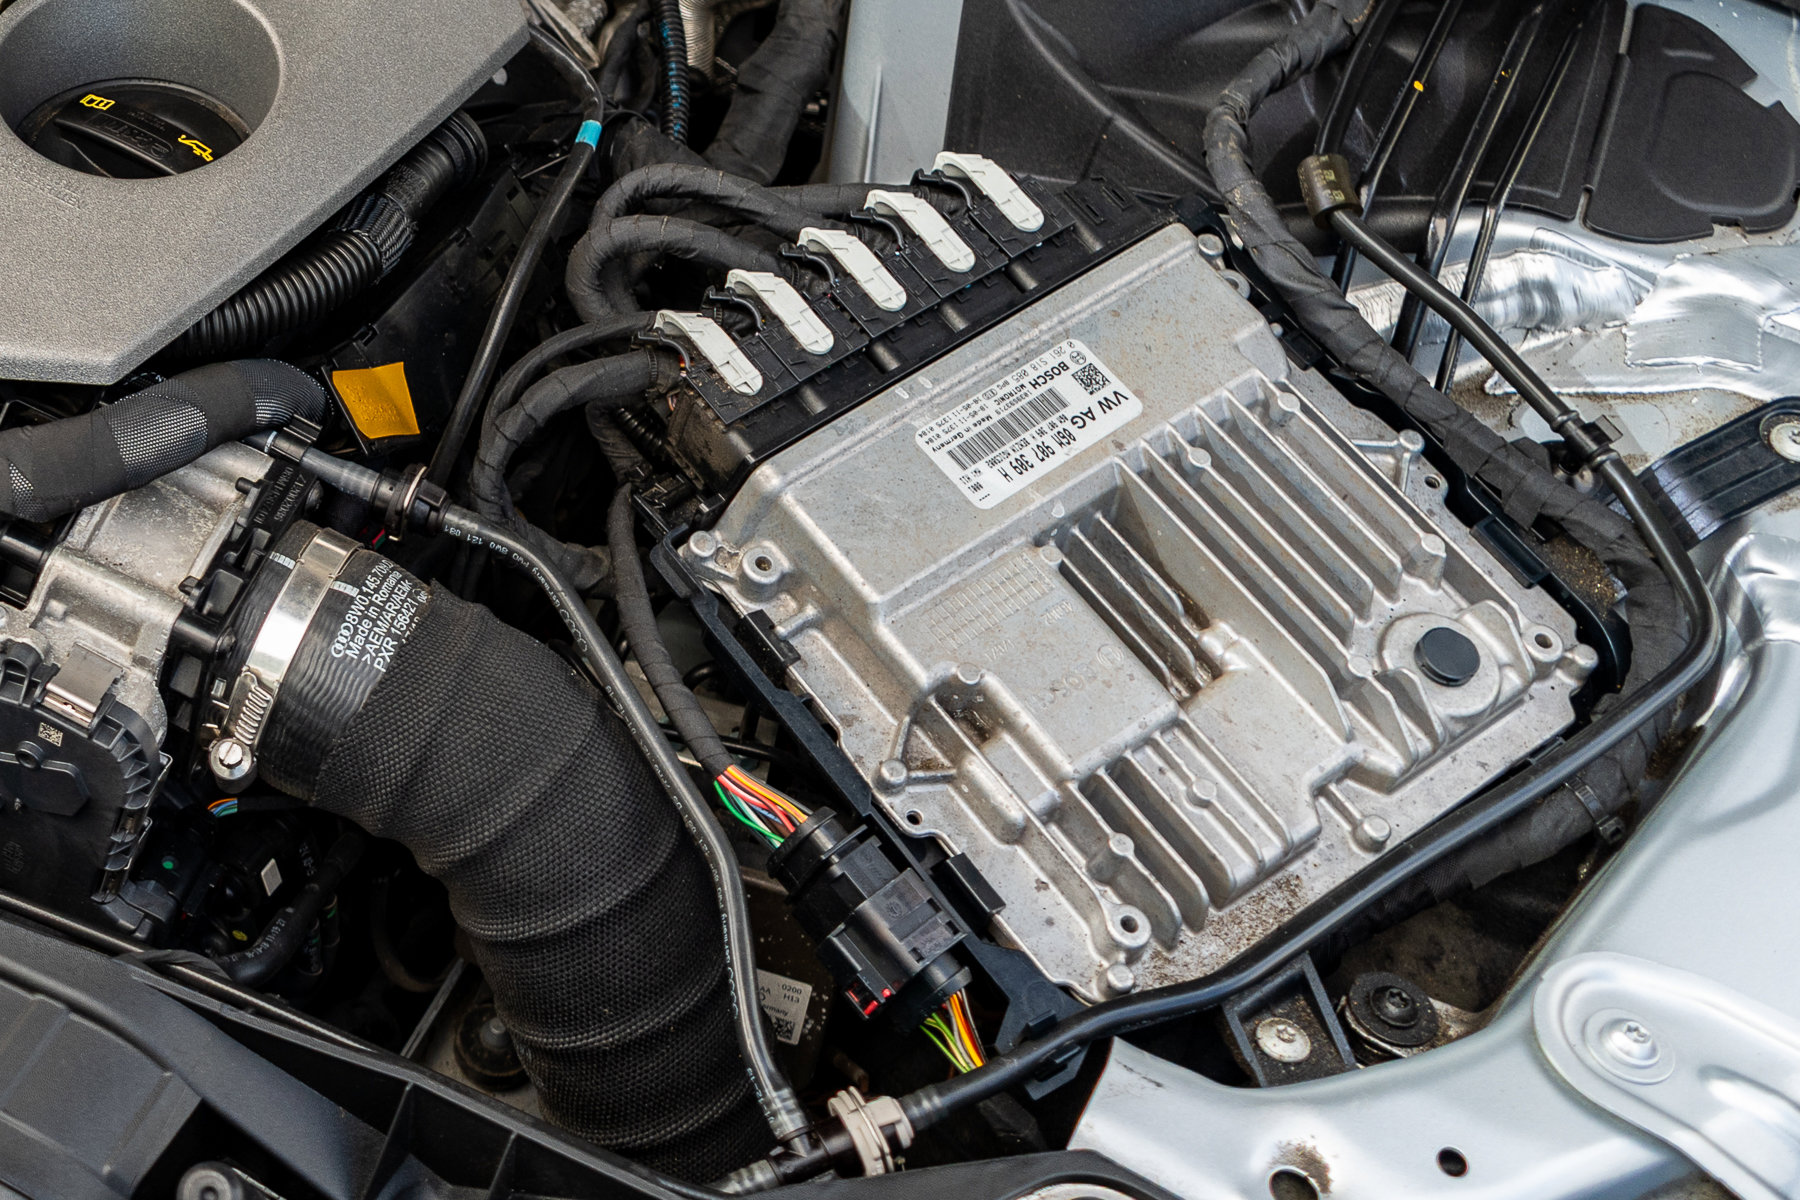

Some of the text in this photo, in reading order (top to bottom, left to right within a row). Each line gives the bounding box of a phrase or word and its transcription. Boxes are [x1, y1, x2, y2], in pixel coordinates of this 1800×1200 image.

[1048, 345, 1065, 360] 261
[1028, 359, 1069, 390] BOSCH
[993, 382, 1027, 407] MOTRONIC
[963, 425, 973, 434] in
[971, 412, 993, 429] Made
[930, 430, 964, 455] Germany
[996, 385, 1128, 484] VW AG 06M 907 309 H
[345, 567, 402, 659] Made in Romania
[372, 635, 397, 673] PXR
[389, 597, 418, 637] 156421
